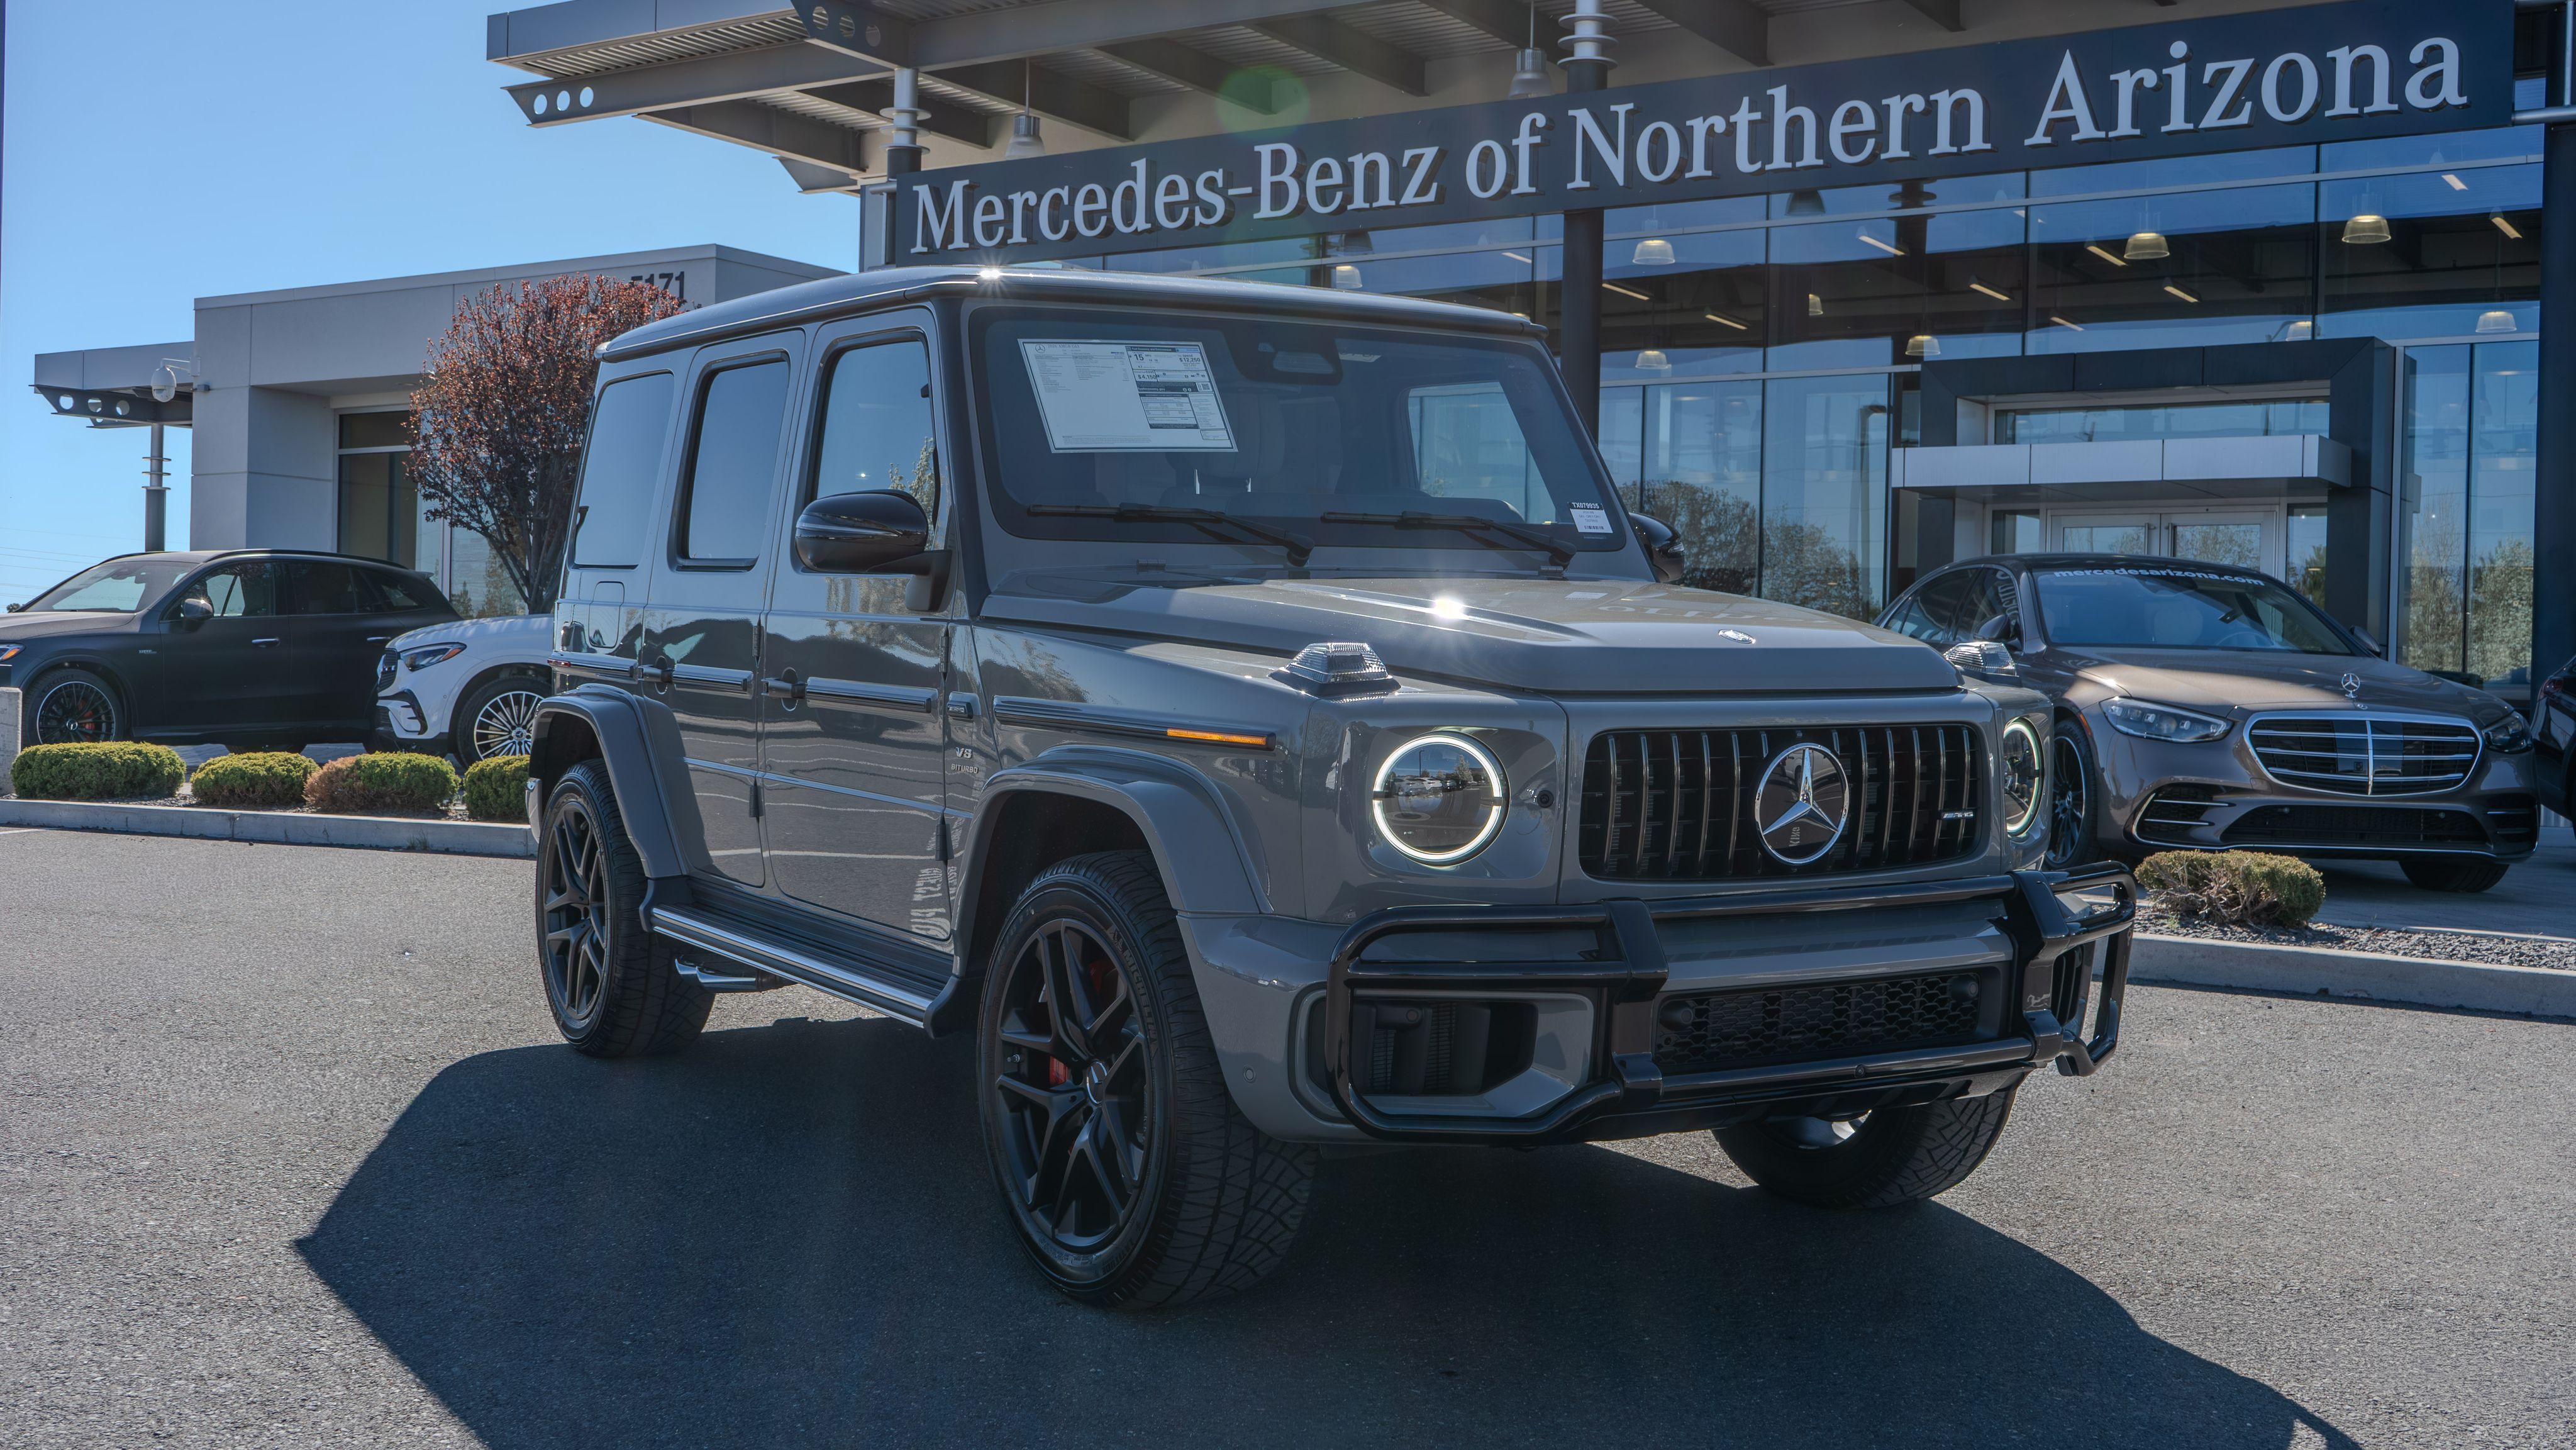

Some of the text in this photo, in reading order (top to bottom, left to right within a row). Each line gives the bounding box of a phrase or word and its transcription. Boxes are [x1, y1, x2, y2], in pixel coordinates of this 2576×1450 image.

[911, 38, 2467, 254] Mercedes-Benz of Northern Arizona
[2053, 568, 2265, 586] mercedesarizona.com
[956, 747, 972, 759] V8
[951, 763, 979, 774] BITURBO
[1123, 947, 1158, 1042] MICHELIN
